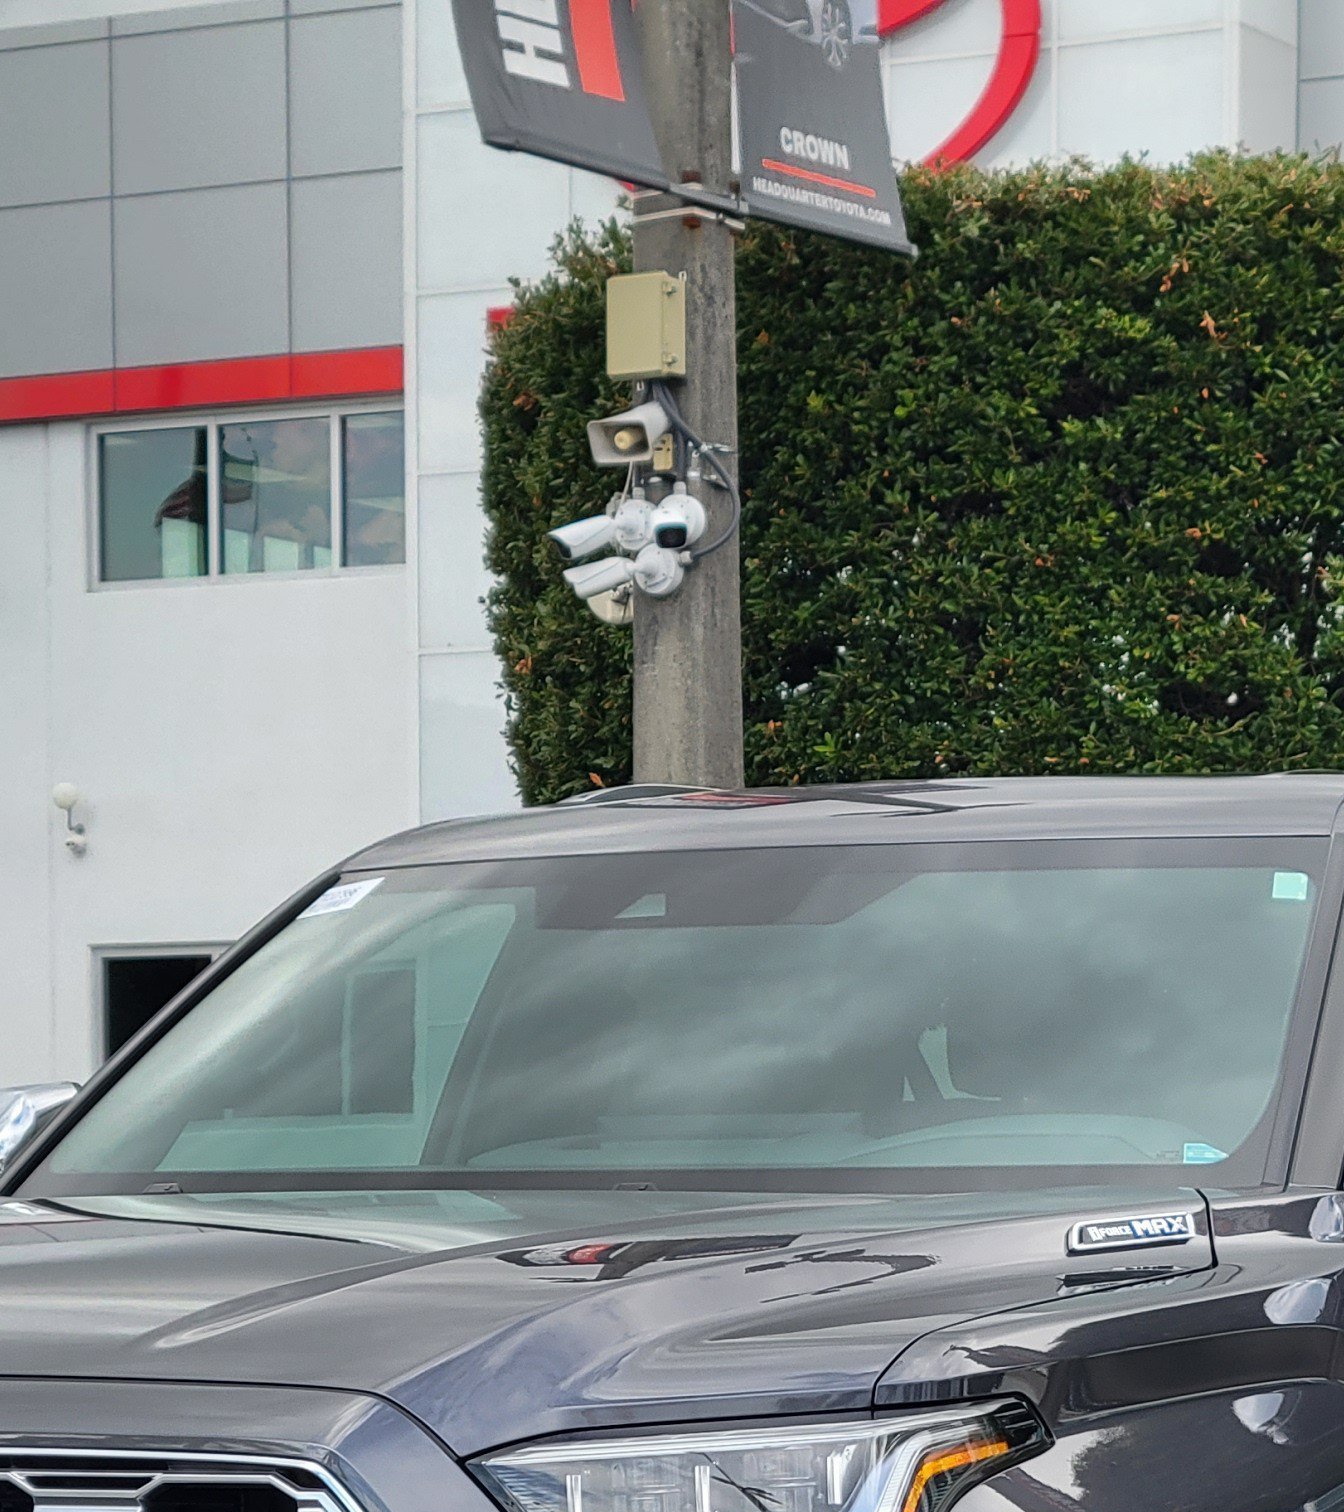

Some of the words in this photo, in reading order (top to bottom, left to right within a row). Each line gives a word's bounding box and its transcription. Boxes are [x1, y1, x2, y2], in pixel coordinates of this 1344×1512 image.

[779, 126, 851, 171] CROWN
[752, 176, 892, 226] HEADQUARTERTOYOTA.COM
[1132, 1216, 1188, 1238] MAX
